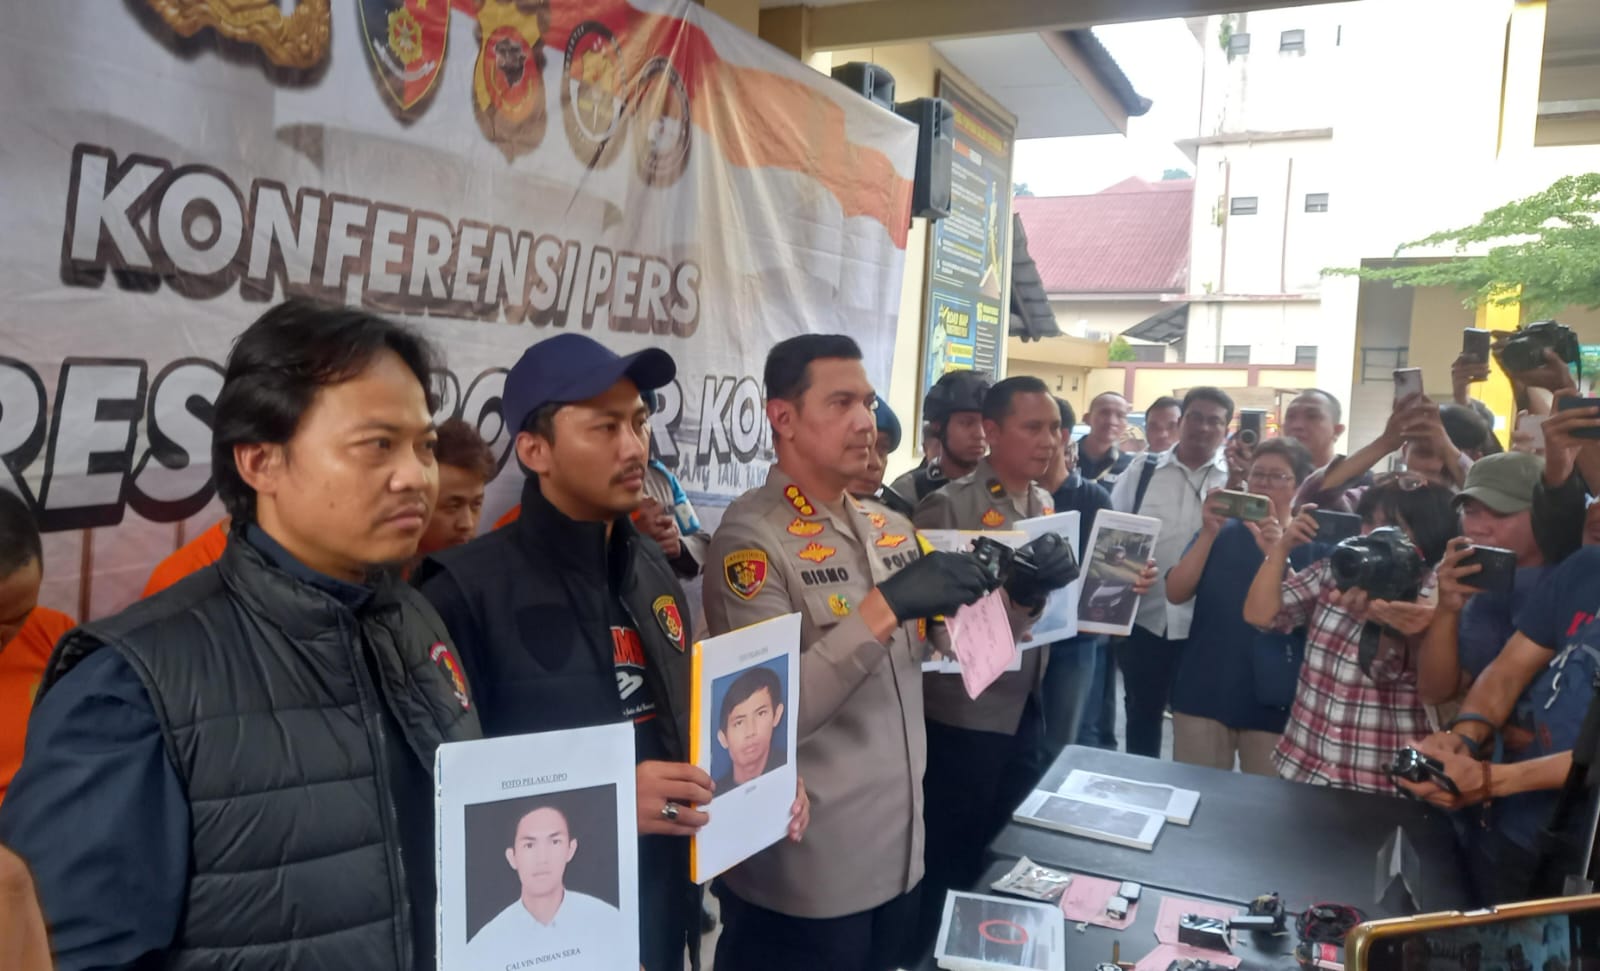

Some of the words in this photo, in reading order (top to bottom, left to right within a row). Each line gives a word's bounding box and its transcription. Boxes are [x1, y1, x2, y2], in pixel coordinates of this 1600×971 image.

[60, 142, 581, 327] KONFERENSI
[582, 245, 700, 338] PERS
[800, 567, 849, 586] BISMO
[502, 779, 521, 790] FOTO
[522, 776, 552, 786] PELAKU
[553, 772, 568, 783] DPO
[505, 960, 534, 971] CALVIN
[535, 952, 561, 965] INDIAN
[562, 947, 582, 958] SERA
